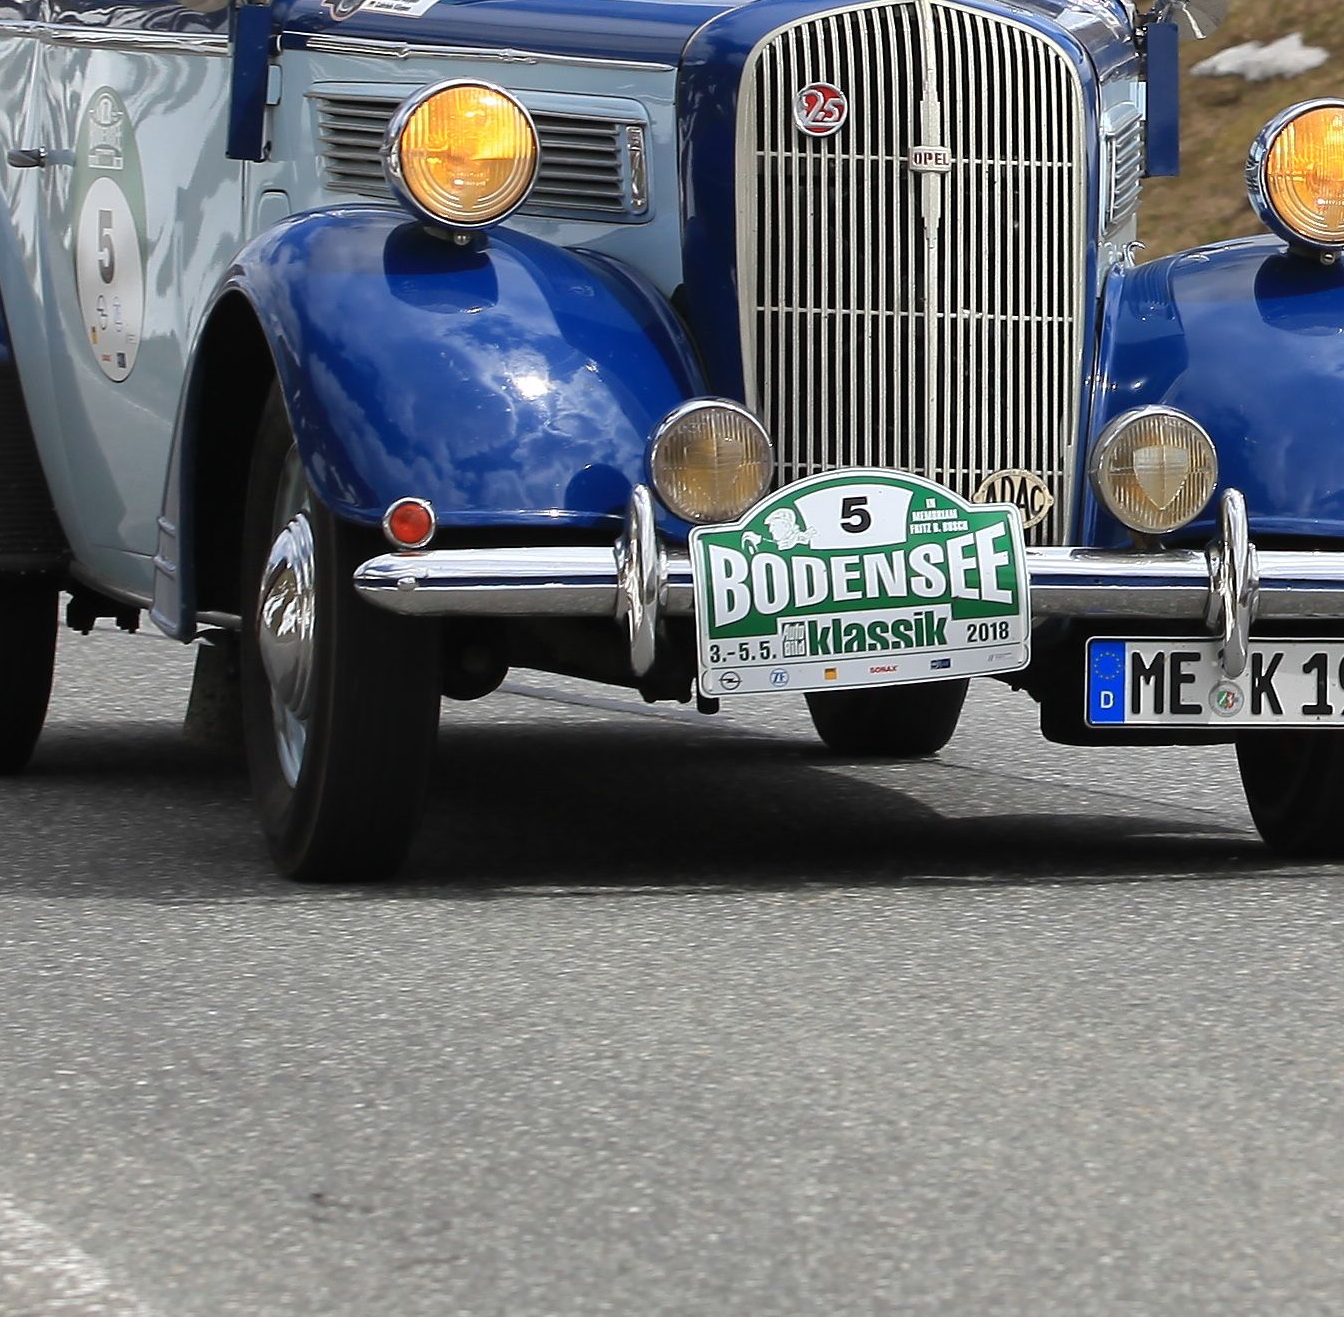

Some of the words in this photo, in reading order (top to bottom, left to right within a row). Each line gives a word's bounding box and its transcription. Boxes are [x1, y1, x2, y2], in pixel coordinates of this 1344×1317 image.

[913, 154, 950, 167] OPEL
[98, 209, 115, 284] 5
[840, 496, 872, 533] 5
[986, 476, 1045, 519] ADAC
[709, 521, 1013, 628] BODENSEE
[807, 611, 948, 656] klassik
[966, 621, 1009, 643] 2018
[1100, 691, 1114, 709] D
[1131, 651, 1203, 715] ME
[1250, 651, 1284, 715] K
